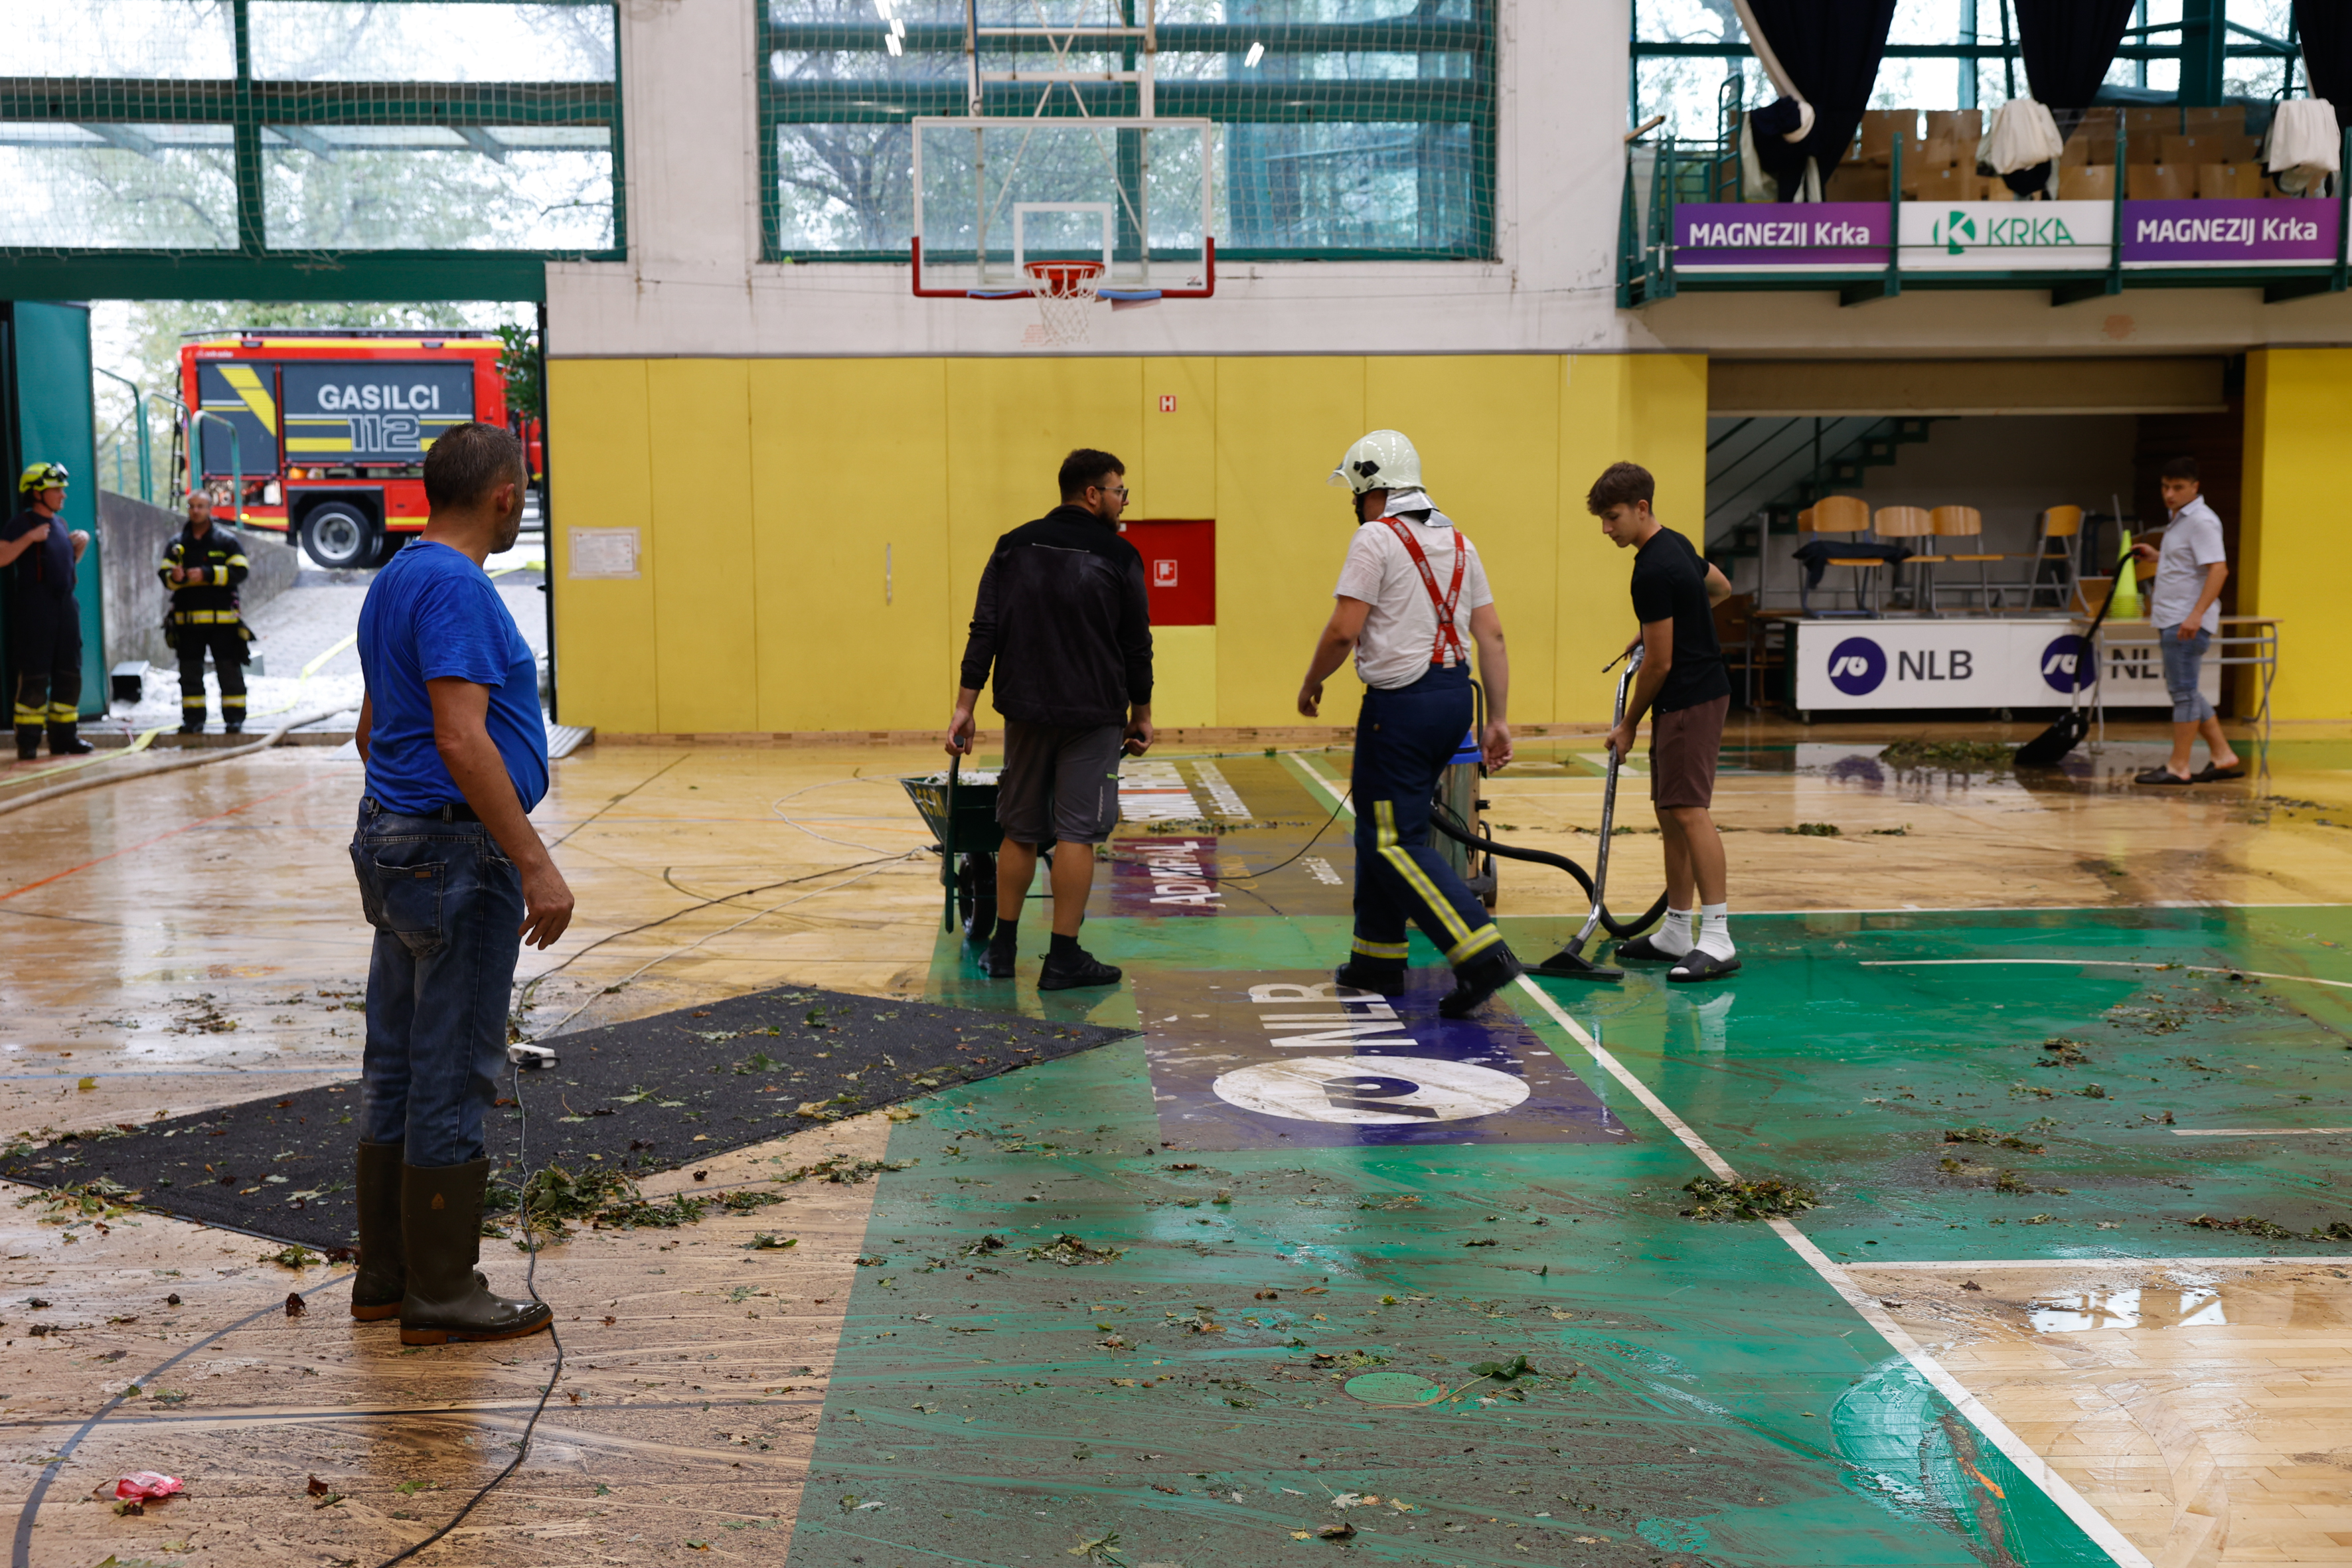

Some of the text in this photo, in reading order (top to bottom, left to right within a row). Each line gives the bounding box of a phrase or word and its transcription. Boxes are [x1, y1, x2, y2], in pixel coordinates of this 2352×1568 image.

[1689, 221, 1871, 247] MAGNEZIJ Krka
[1986, 217, 2076, 246] KRKA
[2136, 217, 2318, 246] MAGNEZIJ Krka
[318, 384, 440, 410] GASILCI
[1162, 396, 1174, 411] H
[347, 413, 421, 453] 112
[1899, 650, 1973, 680] NLB
[2110, 648, 2166, 679] NL
[1135, 840, 1226, 908] ADMIRAL
[1247, 982, 1419, 1048] NLB
